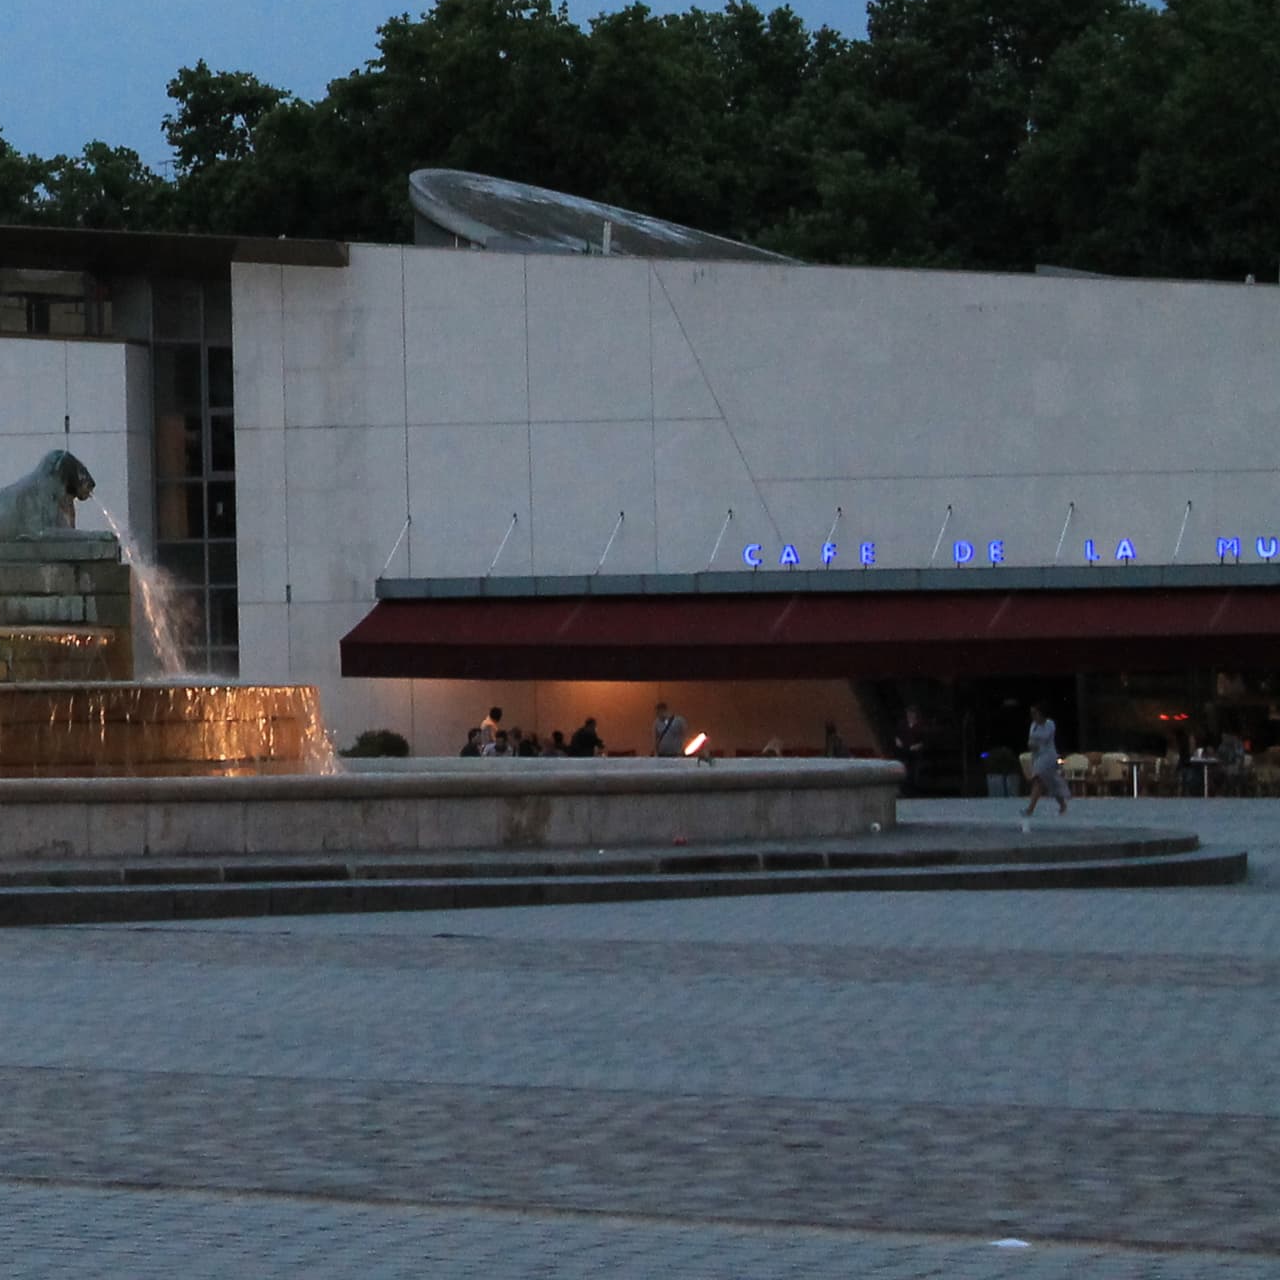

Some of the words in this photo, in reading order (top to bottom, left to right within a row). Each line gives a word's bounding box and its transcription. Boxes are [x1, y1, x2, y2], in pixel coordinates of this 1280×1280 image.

[741, 542, 877, 567] CAFE
[951, 538, 1006, 564] DE
[1083, 537, 1138, 562] LA
